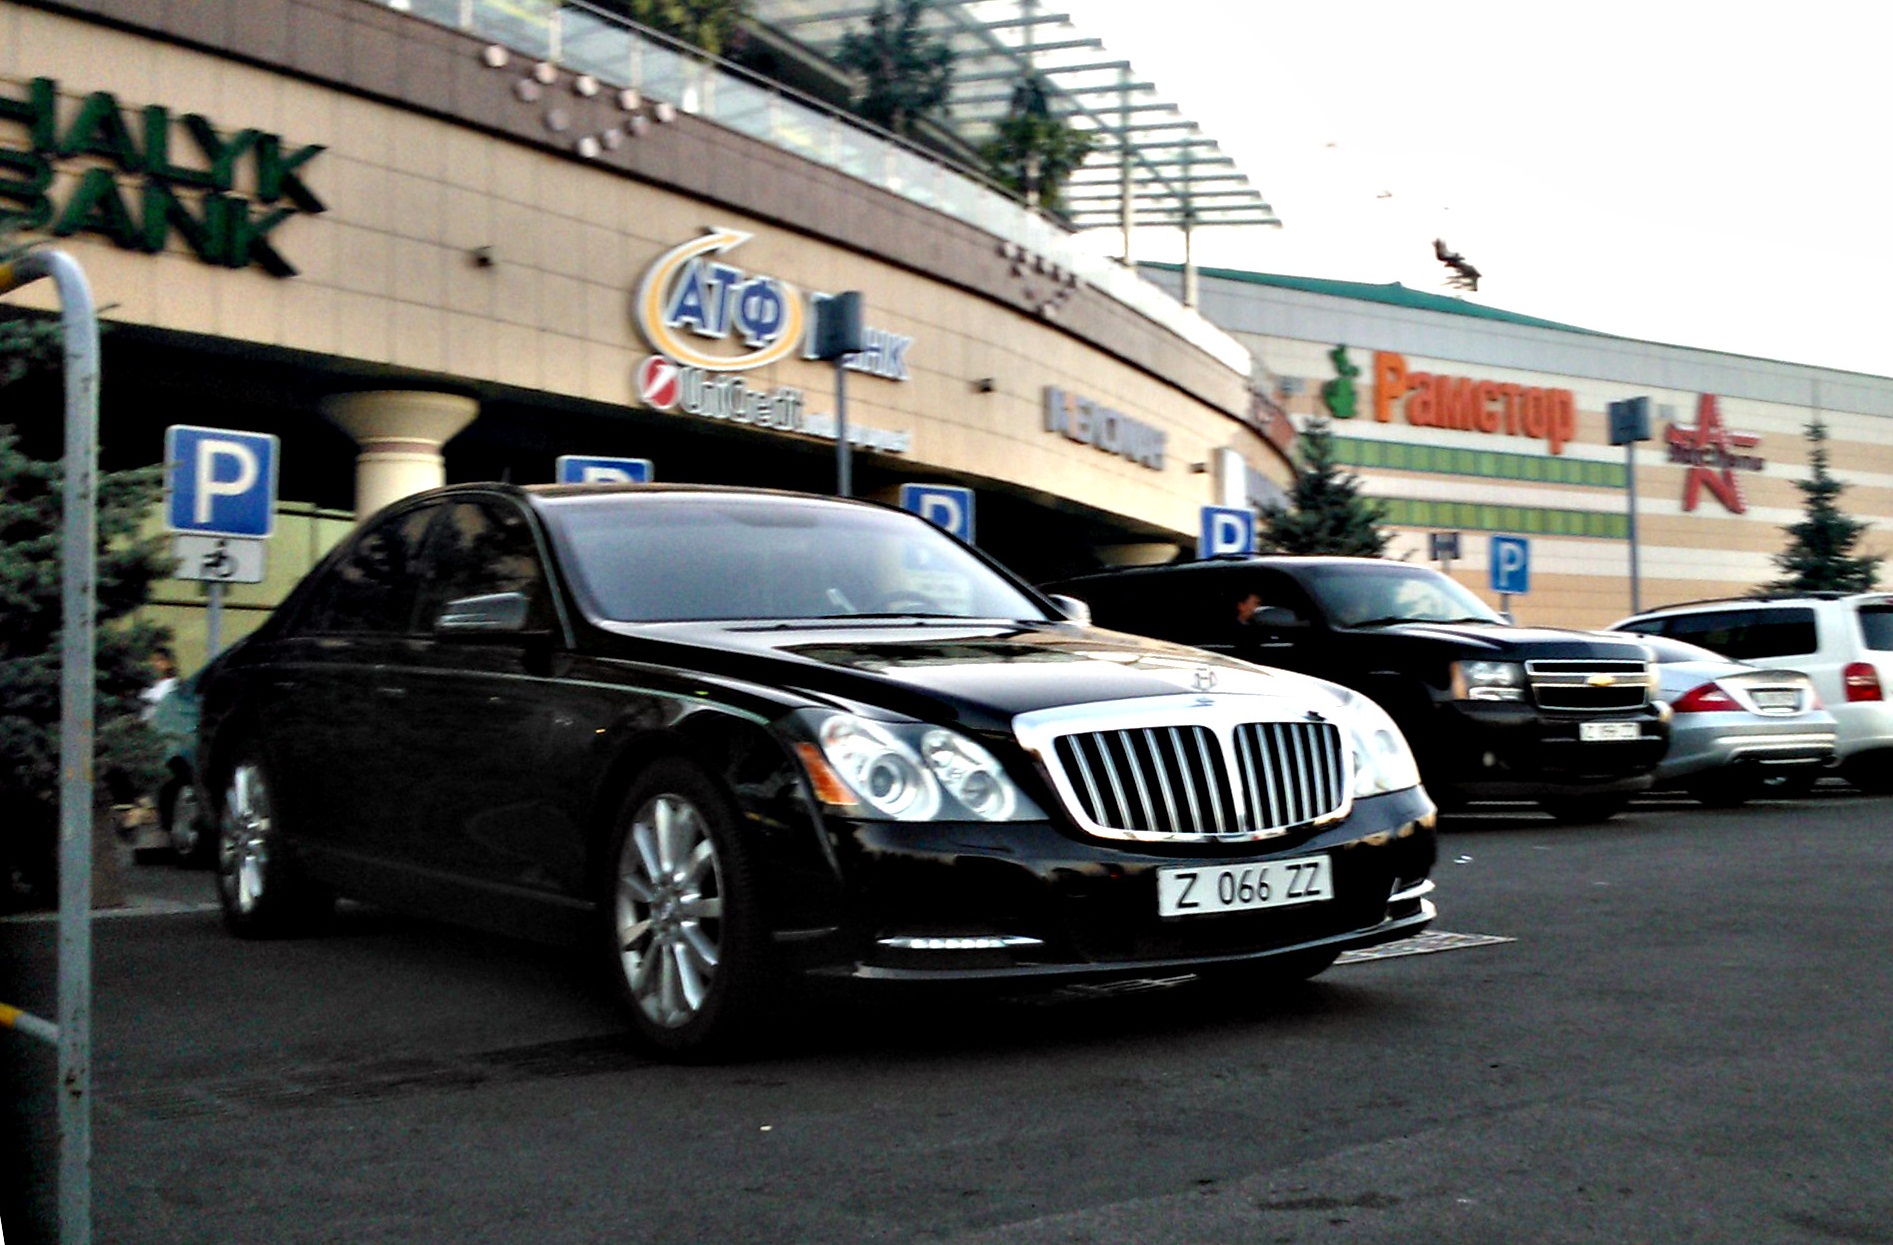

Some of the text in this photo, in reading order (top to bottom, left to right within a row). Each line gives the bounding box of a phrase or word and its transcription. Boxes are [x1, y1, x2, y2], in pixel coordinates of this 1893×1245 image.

[664, 257, 788, 348] АТФ
[1374, 351, 1586, 455] Рамстор
[193, 439, 259, 523] P
[1499, 542, 1525, 587] P
[1174, 861, 1321, 909] Z 066 ZZ
